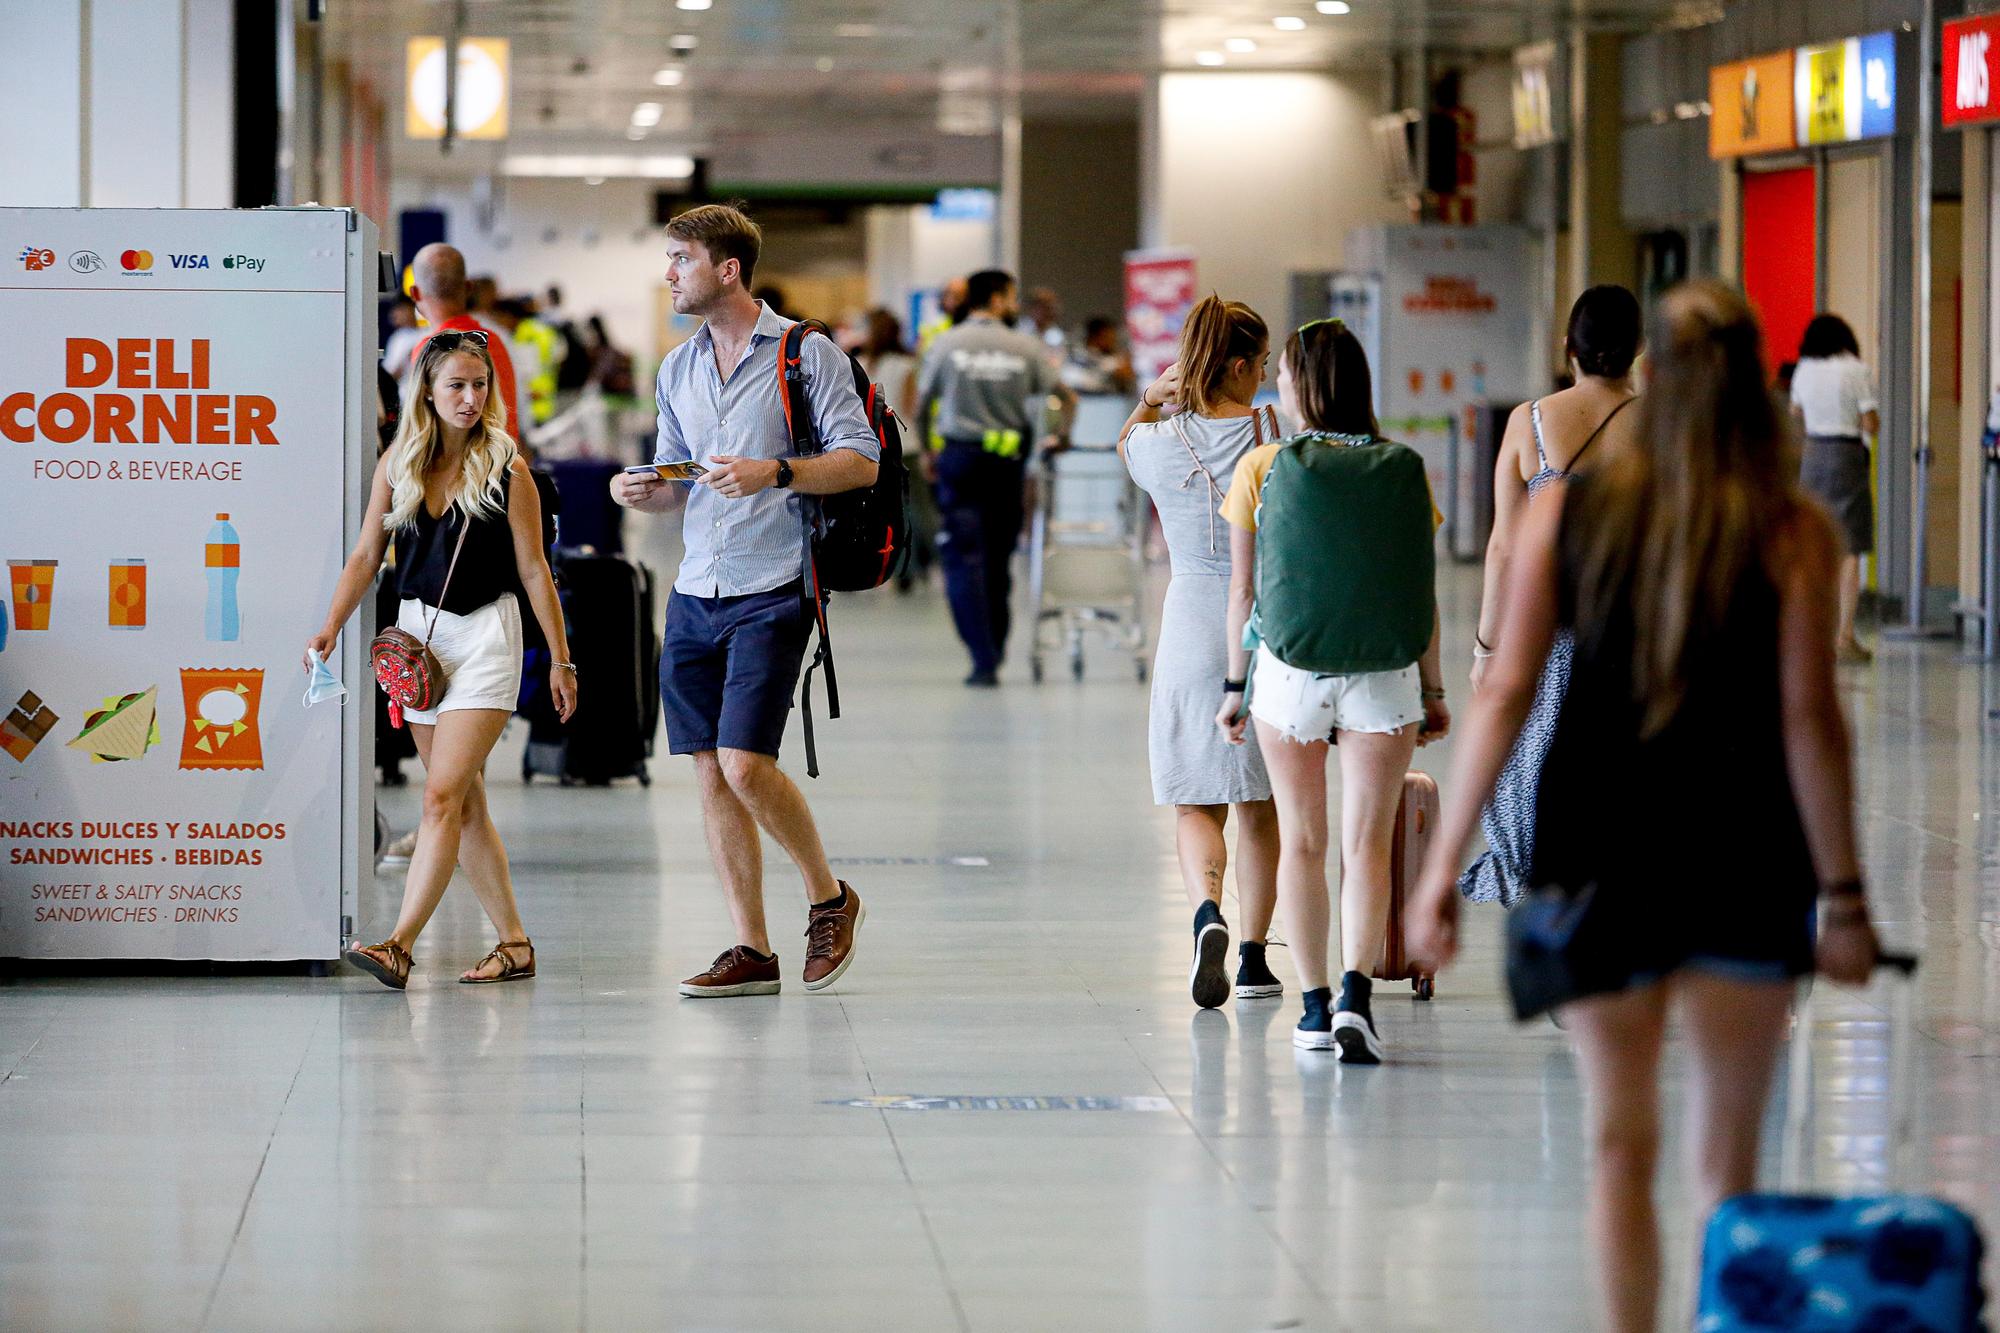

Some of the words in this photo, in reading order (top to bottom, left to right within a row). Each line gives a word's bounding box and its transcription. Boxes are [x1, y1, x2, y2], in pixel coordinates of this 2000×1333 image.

[168, 254, 209, 269] VISA
[236, 254, 266, 273] Pay
[66, 337, 210, 389] DELI
[0, 392, 280, 445] CORNER
[34, 459, 101, 480] FOOD
[107, 460, 123, 480] &
[129, 460, 242, 481] BEVERAGE
[81, 822, 159, 839] DULCES
[166, 822, 181, 839] Y
[187, 822, 286, 840] SALADOS
[10, 847, 154, 866] SANDWICHES
[175, 848, 263, 866] BEBIDAS
[31, 883, 92, 900] SWEET
[95, 884, 109, 900] &
[114, 884, 164, 900] SALTY
[168, 884, 242, 901] SNACKS
[34, 906, 157, 923] SANDWICHES
[174, 907, 239, 923] DRINKS
